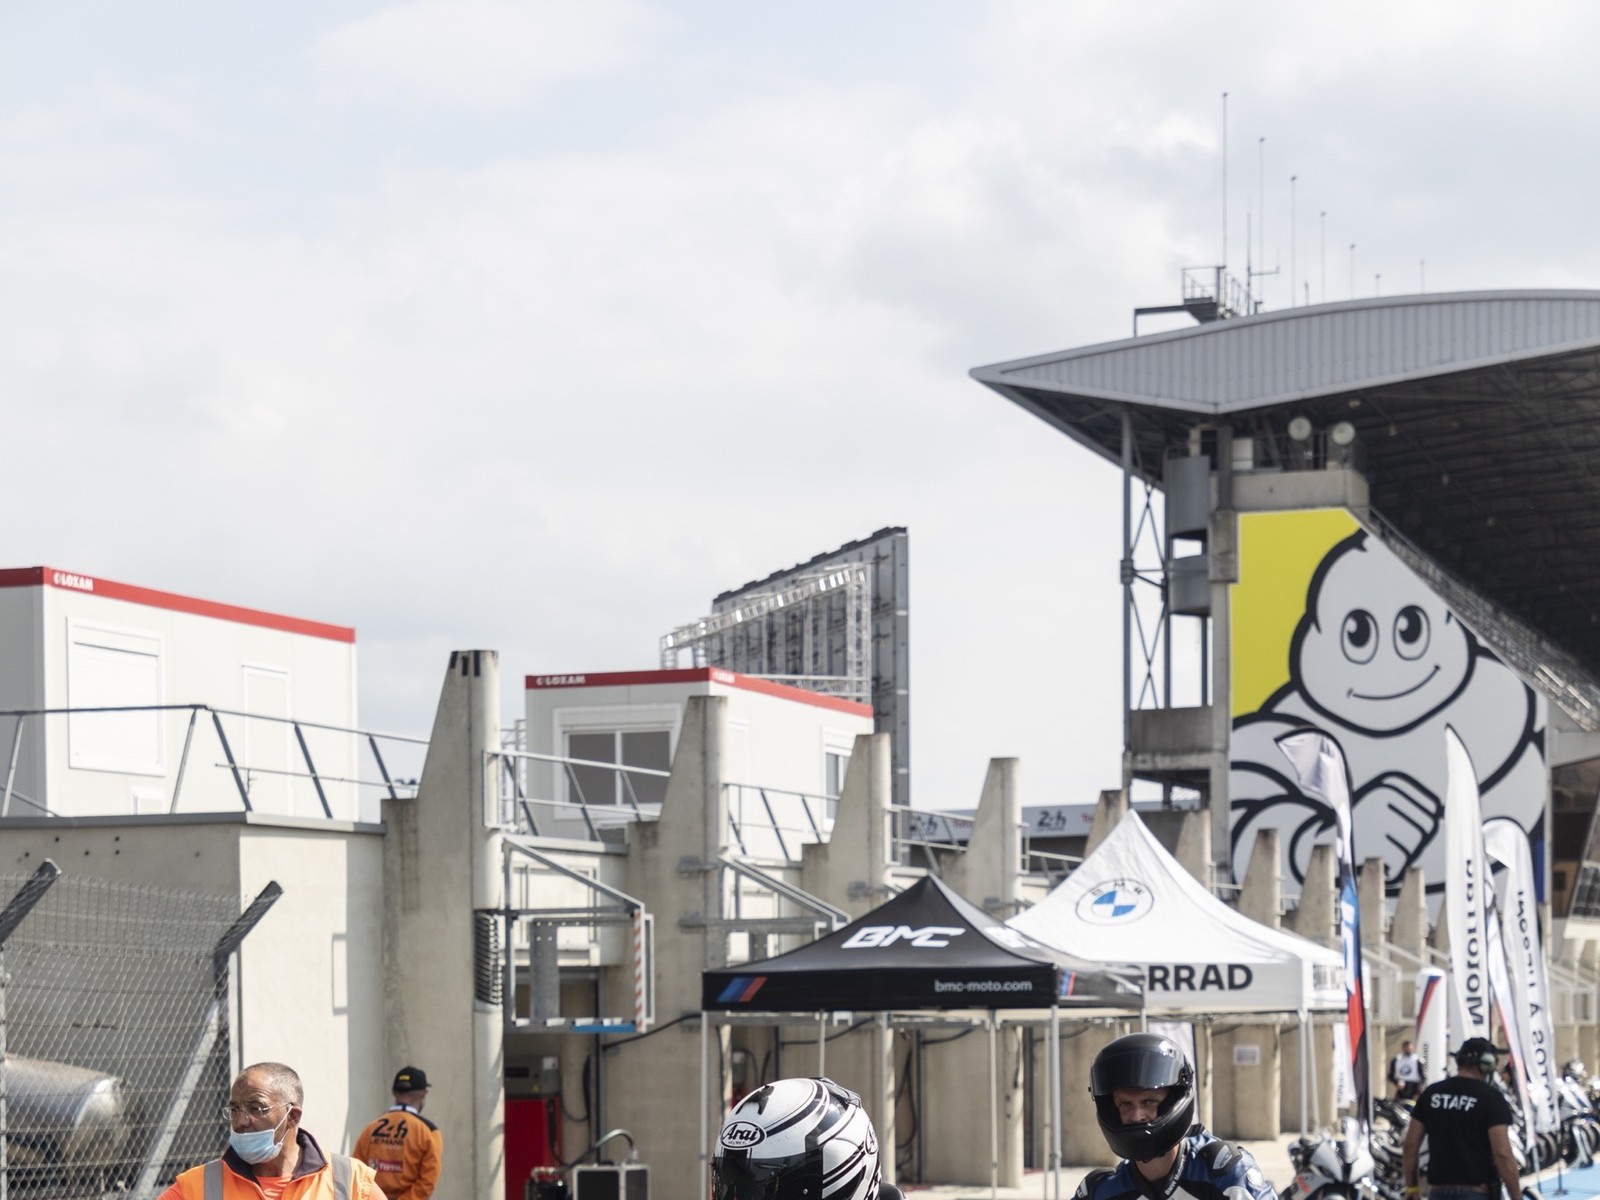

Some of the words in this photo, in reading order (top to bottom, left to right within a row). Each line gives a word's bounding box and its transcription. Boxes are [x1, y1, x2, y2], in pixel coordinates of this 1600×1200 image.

[840, 925, 967, 949] BMC
[933, 979, 1033, 993] bmc-moto.com
[1430, 1093, 1478, 1112] STAFF
[723, 1124, 758, 1142] Arai
